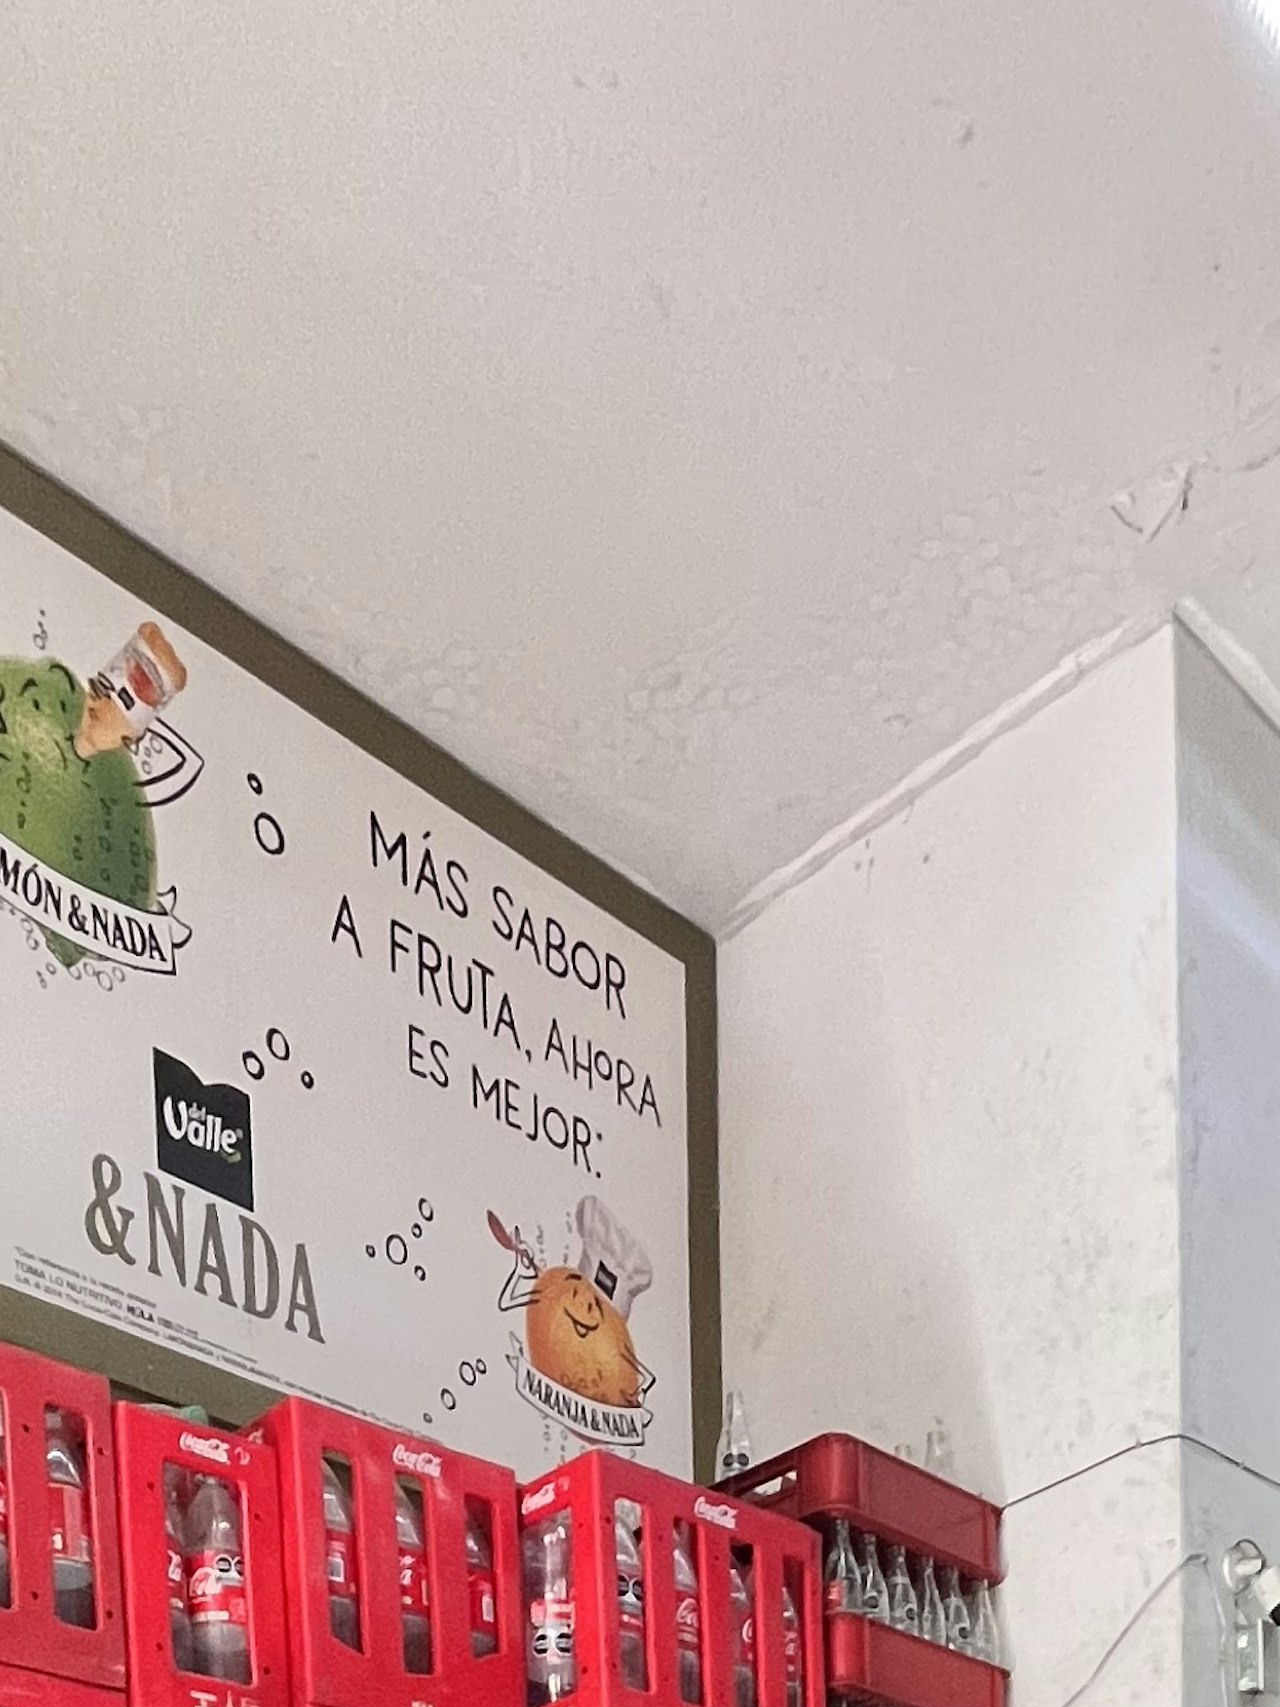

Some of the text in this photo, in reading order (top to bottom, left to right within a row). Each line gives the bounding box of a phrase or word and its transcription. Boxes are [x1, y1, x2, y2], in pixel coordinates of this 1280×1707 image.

[329, 894, 663, 1130] A FRUTA, AHORA
[370, 809, 628, 1020] MÁS SABOR
[407, 1025, 452, 1090] ES
